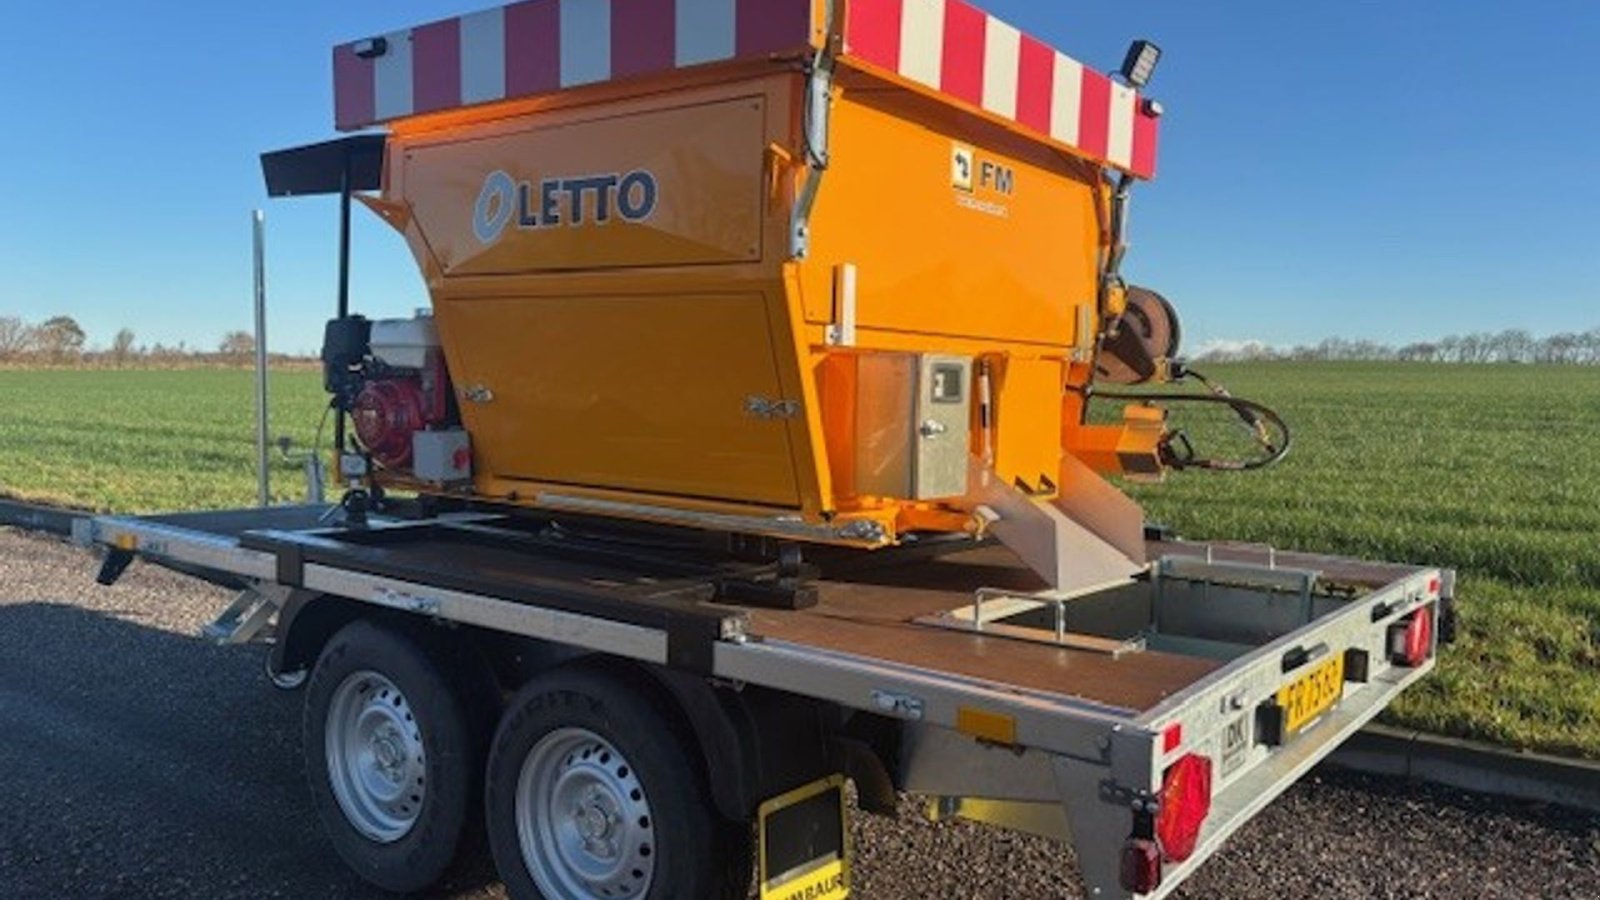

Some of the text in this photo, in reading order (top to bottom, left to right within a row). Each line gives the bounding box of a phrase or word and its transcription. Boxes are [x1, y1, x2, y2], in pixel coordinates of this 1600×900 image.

[980, 160, 1014, 196] FM
[473, 169, 657, 244] OLETTO
[1226, 717, 1245, 749] DK
[784, 872, 845, 900] MBAUR
